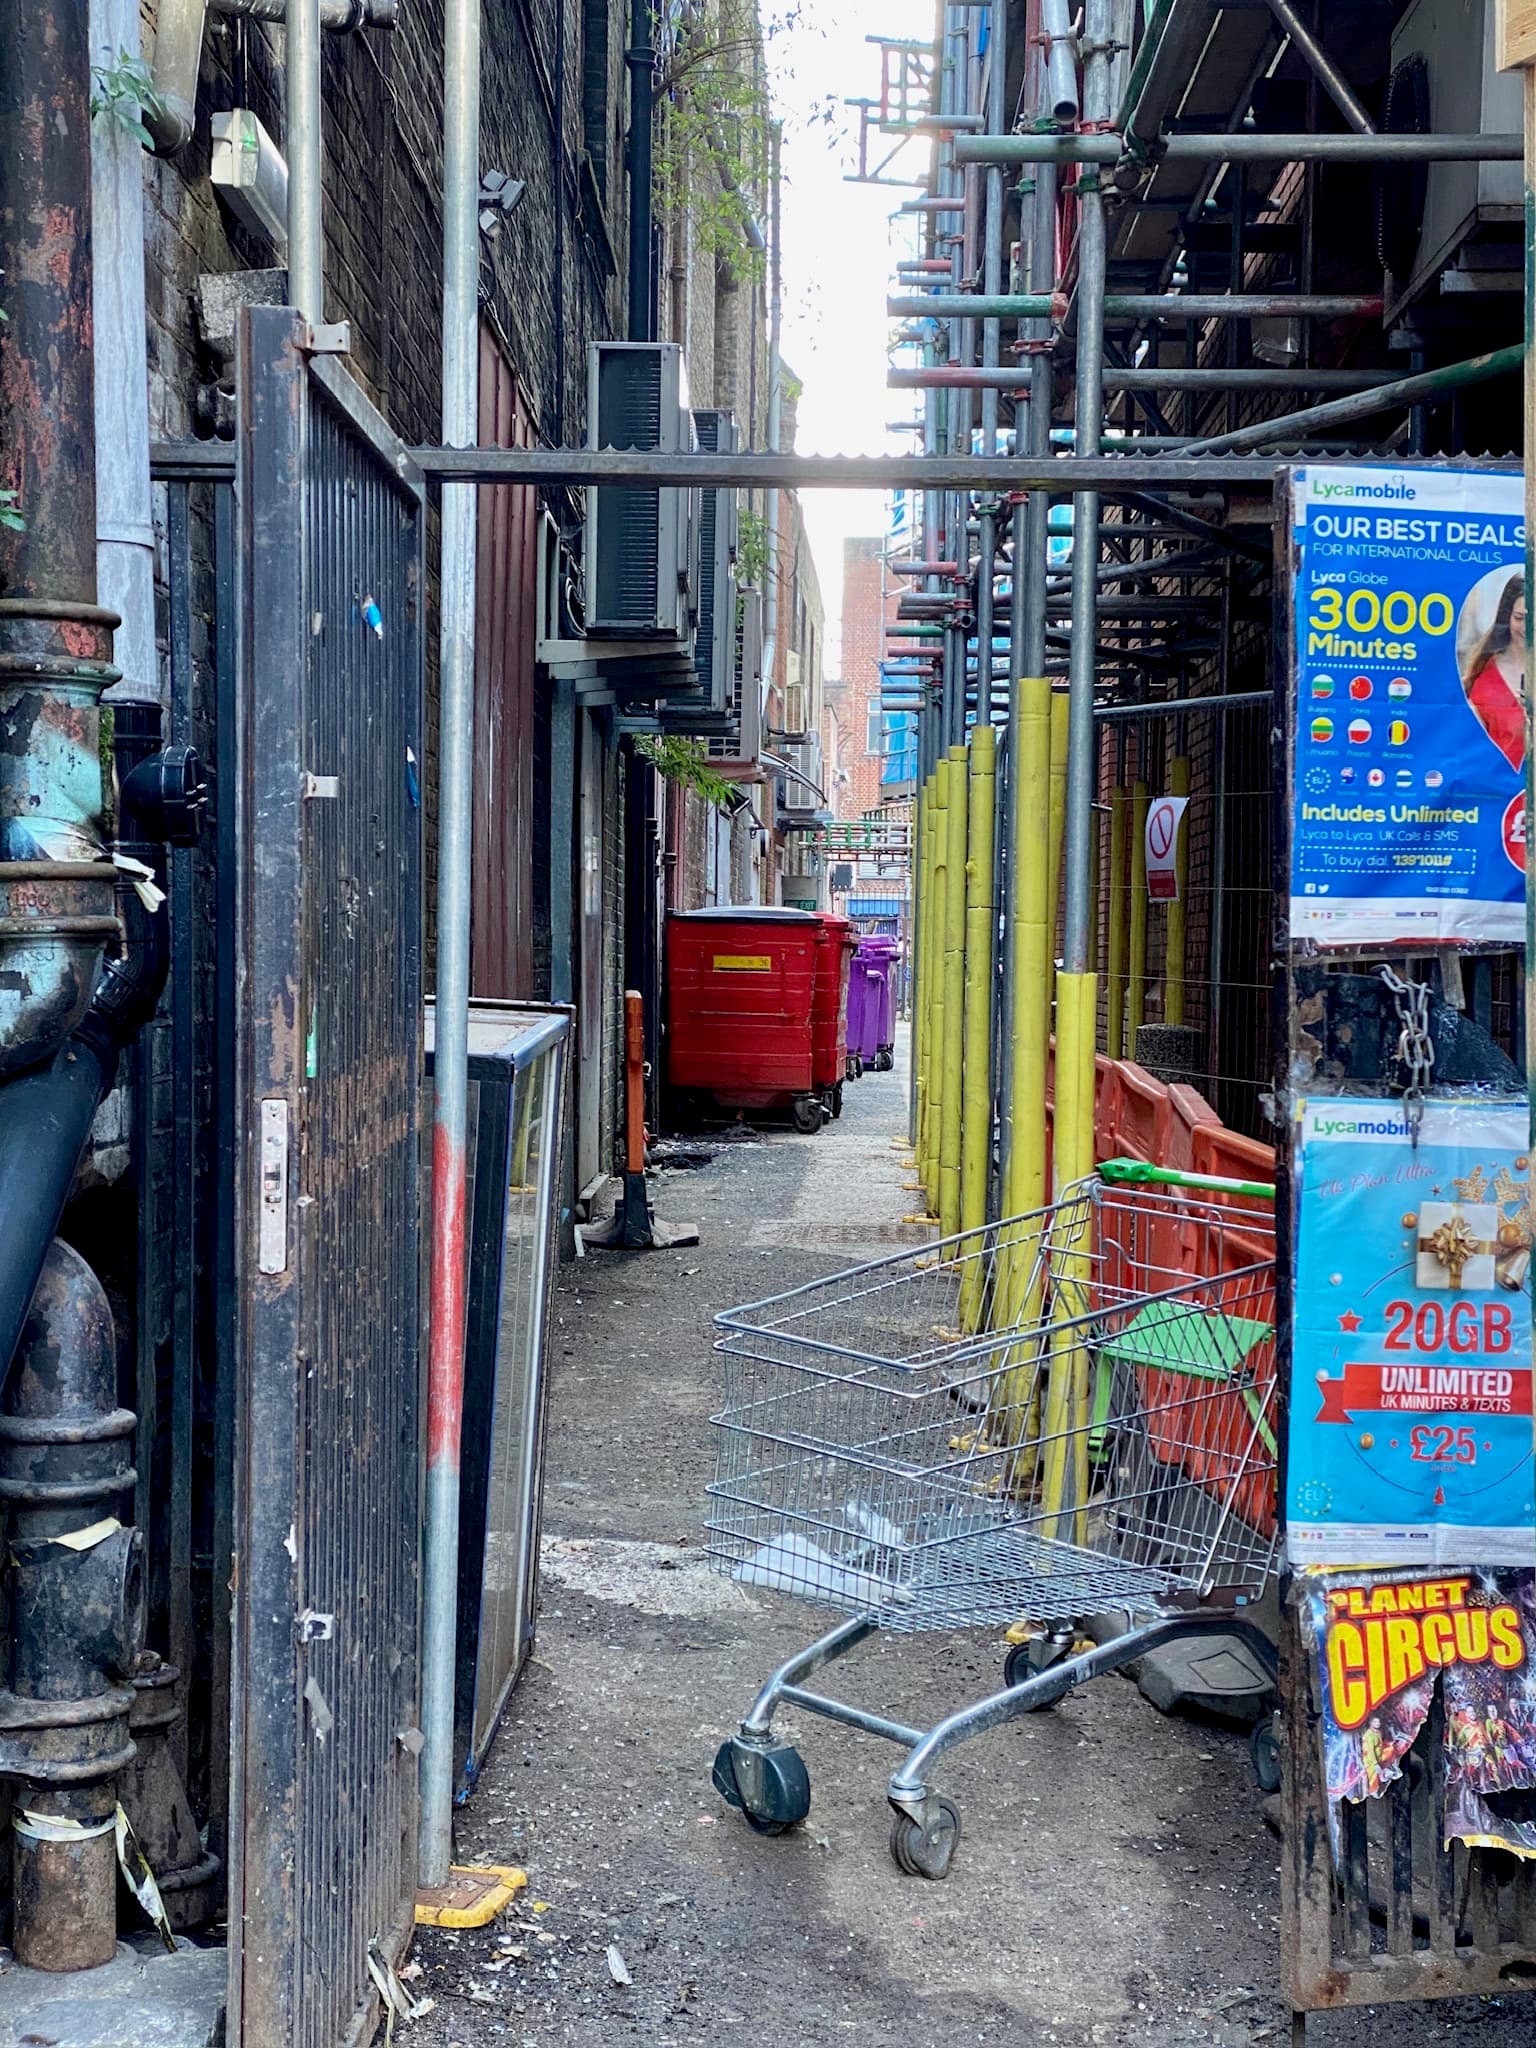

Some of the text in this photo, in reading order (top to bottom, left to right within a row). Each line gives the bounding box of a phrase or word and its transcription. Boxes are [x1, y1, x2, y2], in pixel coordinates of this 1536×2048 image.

[1313, 479, 1416, 501] Lycamobile
[1313, 515, 1526, 548] OUR BEST DEALS
[1312, 543, 1503, 565] FOR INTERNATIONAL CALLS
[1311, 569, 1388, 585] Lyca Globe
[1309, 587, 1454, 637] 3000
[1308, 633, 1417, 661] Minutes
[1302, 802, 1386, 823] Includes
[1301, 829, 1328, 841] Lyca
[1331, 830, 1344, 840] to
[1346, 829, 1373, 842] Lyca
[1379, 830, 1395, 841] UK
[1433, 830, 1460, 842] SMS
[1322, 853, 1337, 866] To
[1339, 854, 1364, 868] buy
[1384, 1301, 1513, 1354] 20GB
[1381, 1366, 1513, 1397] UNLIMITED
[1380, 1394, 1512, 1413] UK MINUTES & TEXTS
[1410, 1425, 1476, 1464] £25
[1330, 1580, 1469, 1617] PLANET
[1329, 1606, 1522, 1727] CIRCUS
